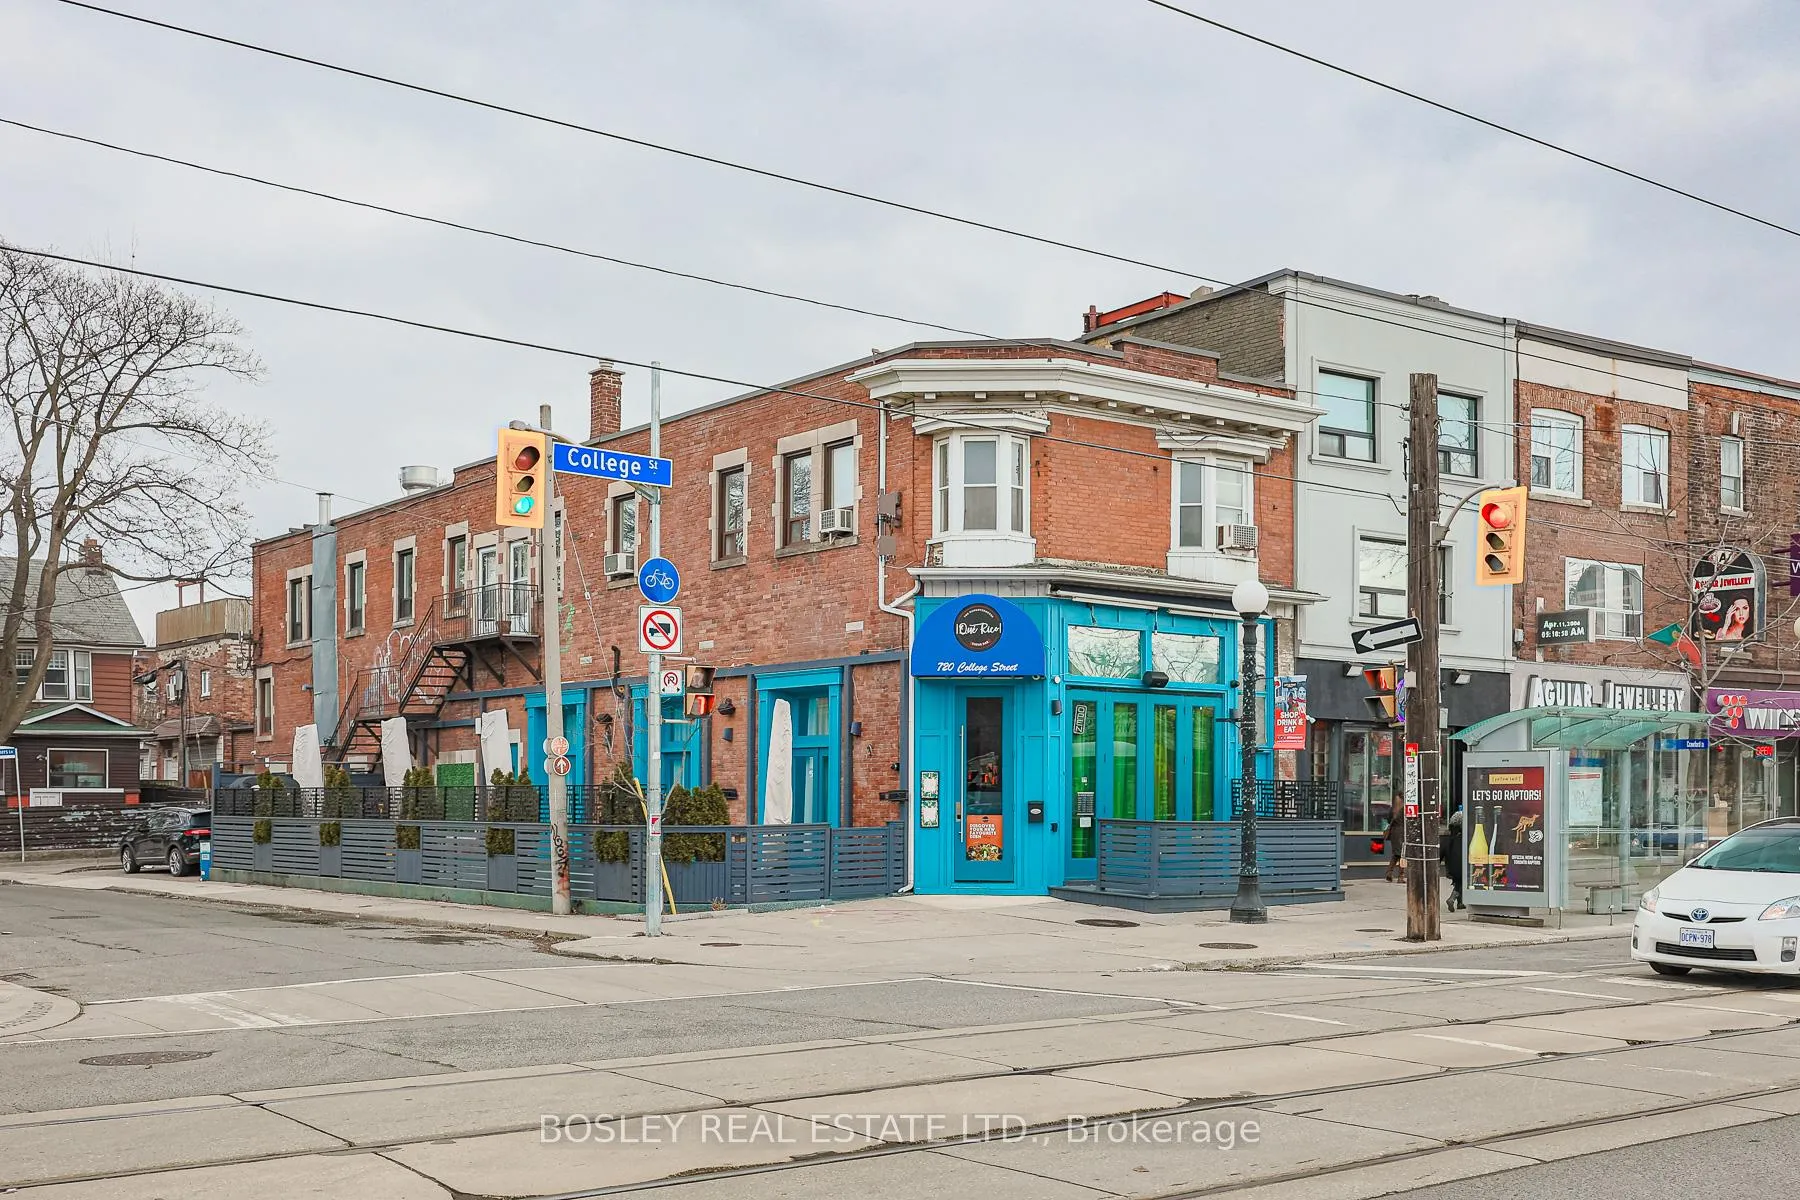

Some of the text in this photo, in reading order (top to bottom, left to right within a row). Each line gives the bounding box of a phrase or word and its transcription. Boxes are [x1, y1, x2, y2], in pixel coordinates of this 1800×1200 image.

[567, 448, 658, 478] College St
[979, 622, 999, 635] Rico
[1570, 626, 1585, 636] AM
[937, 662, 1019, 675] 720 College Street
[1531, 677, 1686, 711] AGUIAR JEWELLERY
[1074, 706, 1085, 733] OPEN
[1276, 718, 1304, 726] DRINK &
[1472, 790, 1542, 801] LET'S GO RAPTORS!
